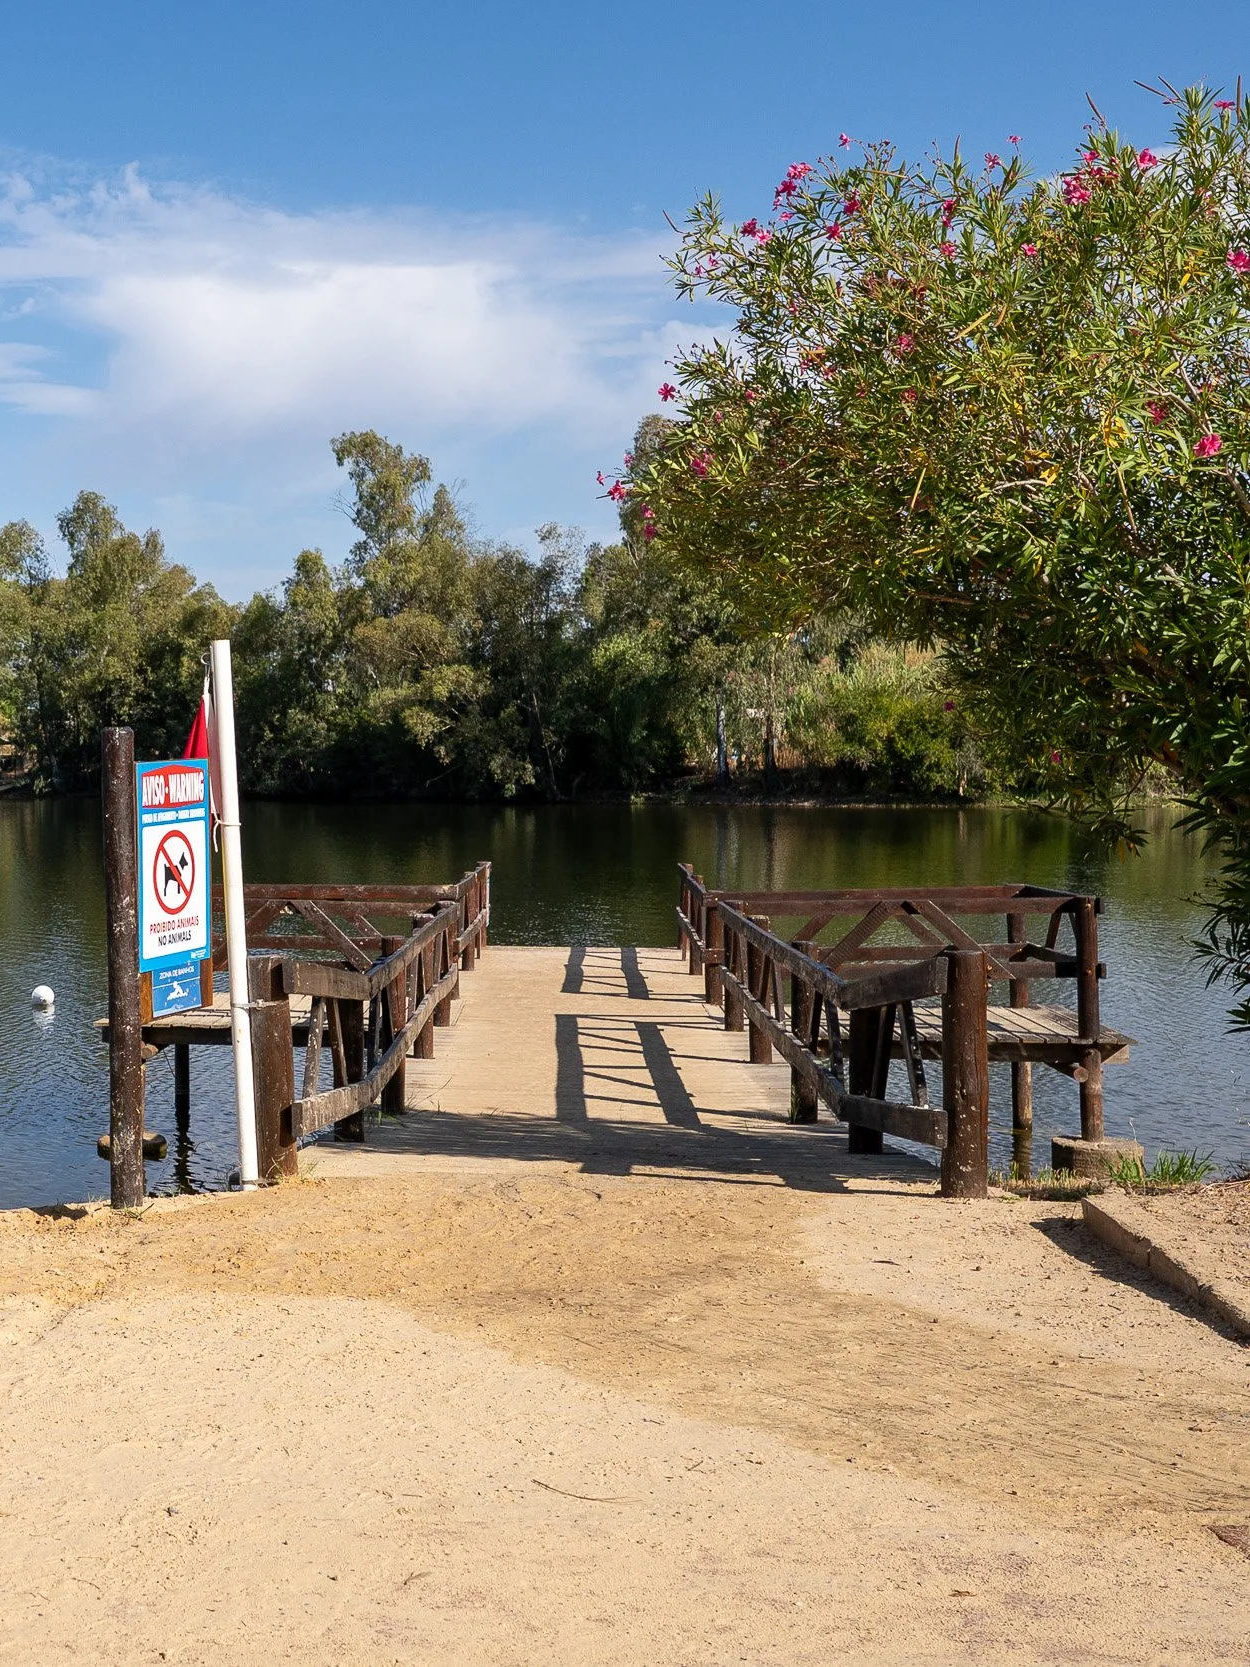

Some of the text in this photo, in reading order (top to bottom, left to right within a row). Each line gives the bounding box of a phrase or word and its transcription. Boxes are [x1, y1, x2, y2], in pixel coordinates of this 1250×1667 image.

[142, 774, 165, 807] AVISO
[168, 771, 205, 804] WARNING
[150, 915, 199, 935] PROIBIDO ANIMAIS
[158, 929, 192, 947] NO ANIMALS
